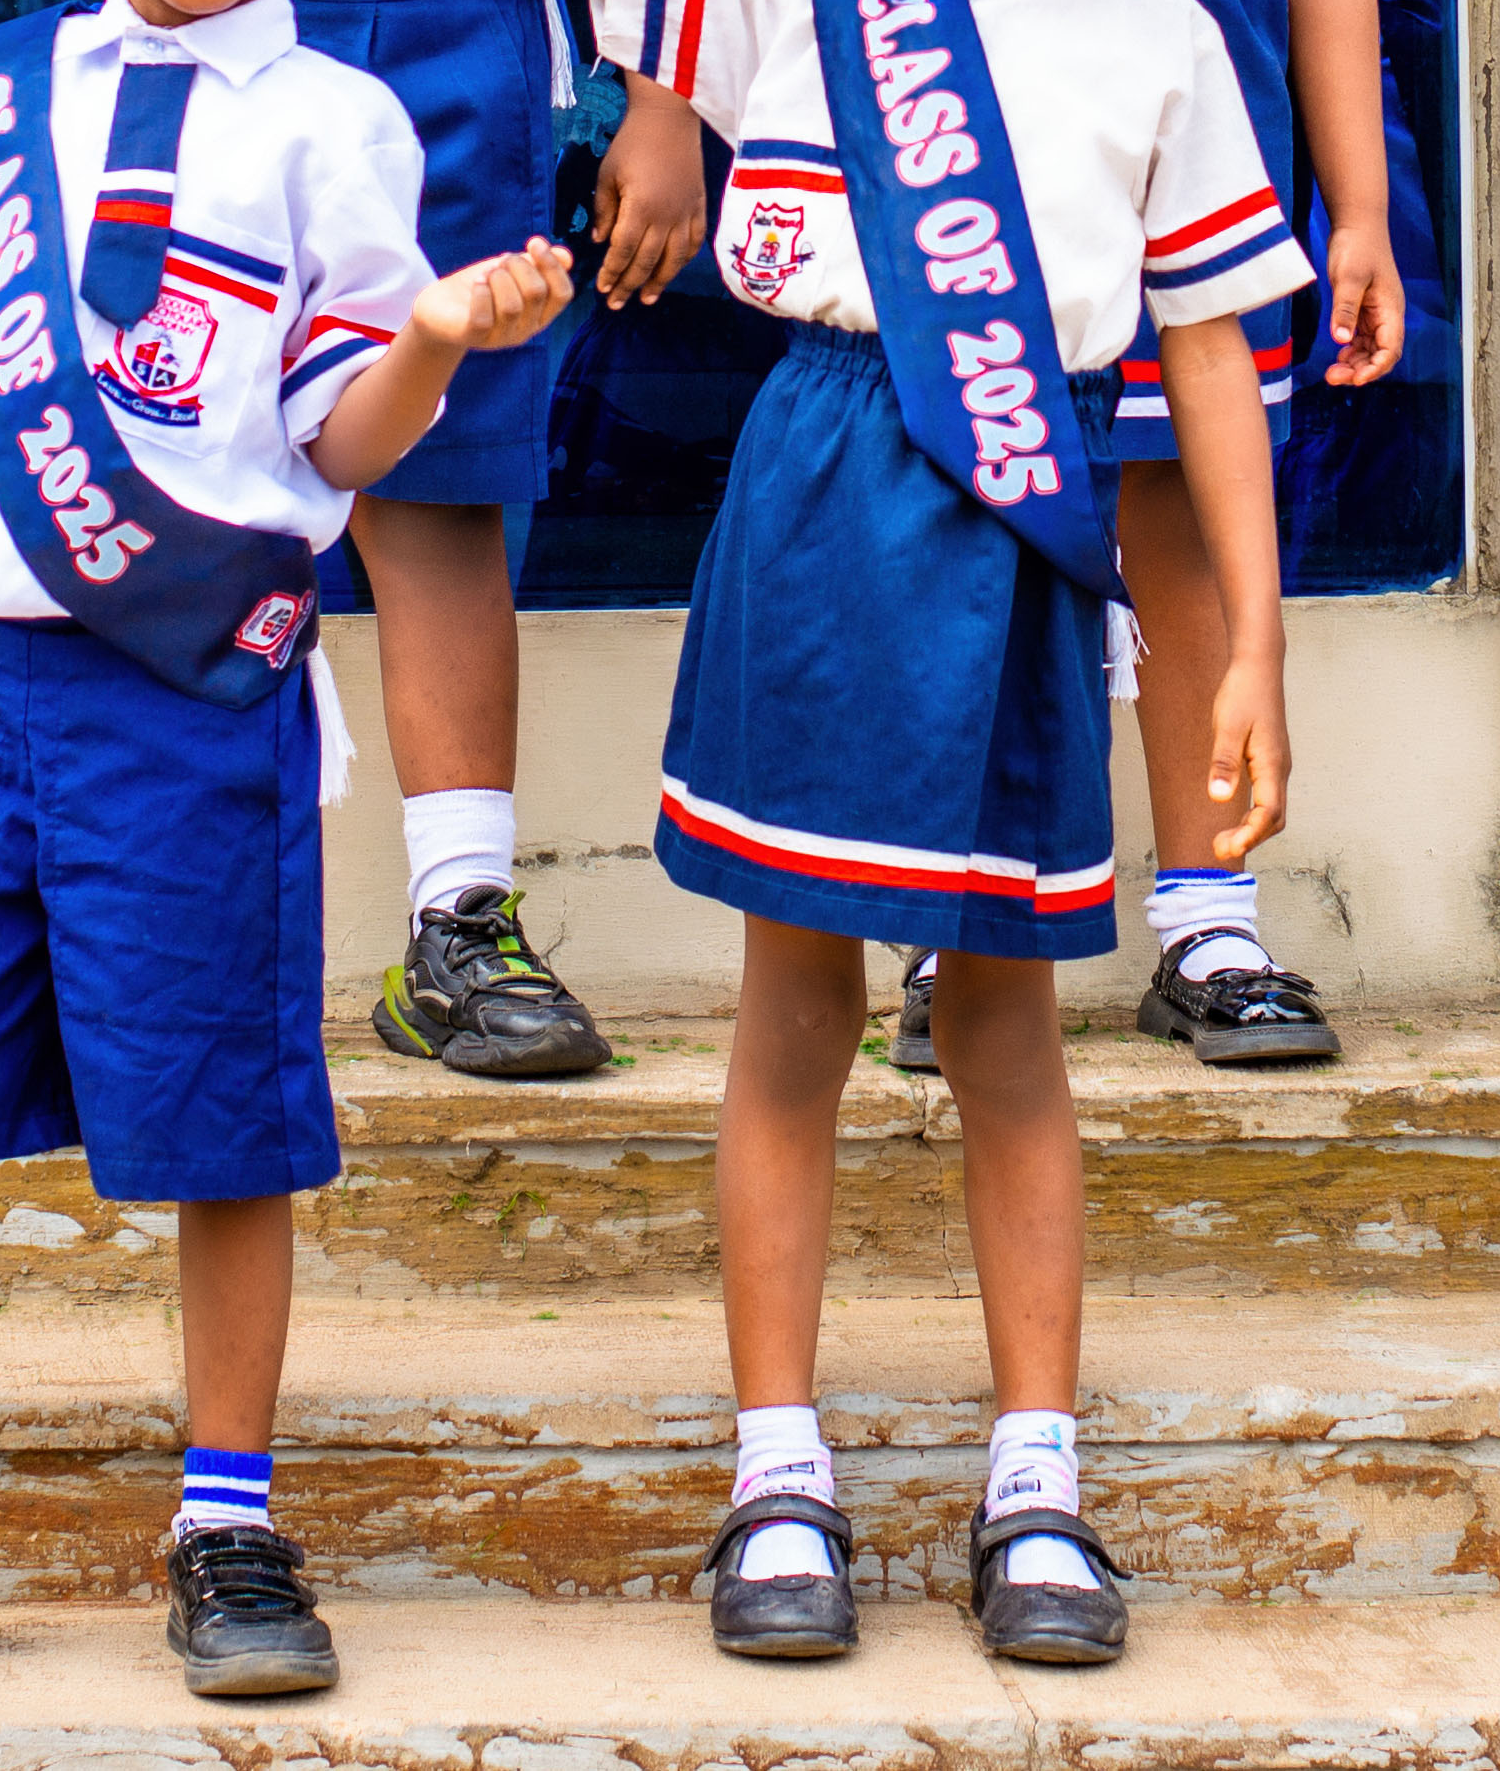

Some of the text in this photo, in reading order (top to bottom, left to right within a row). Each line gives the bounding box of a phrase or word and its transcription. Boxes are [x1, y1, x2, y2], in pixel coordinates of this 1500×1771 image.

[915, 198, 1017, 295] OF
[16, 404, 155, 584] 2025
[946, 320, 1062, 506] 2025
